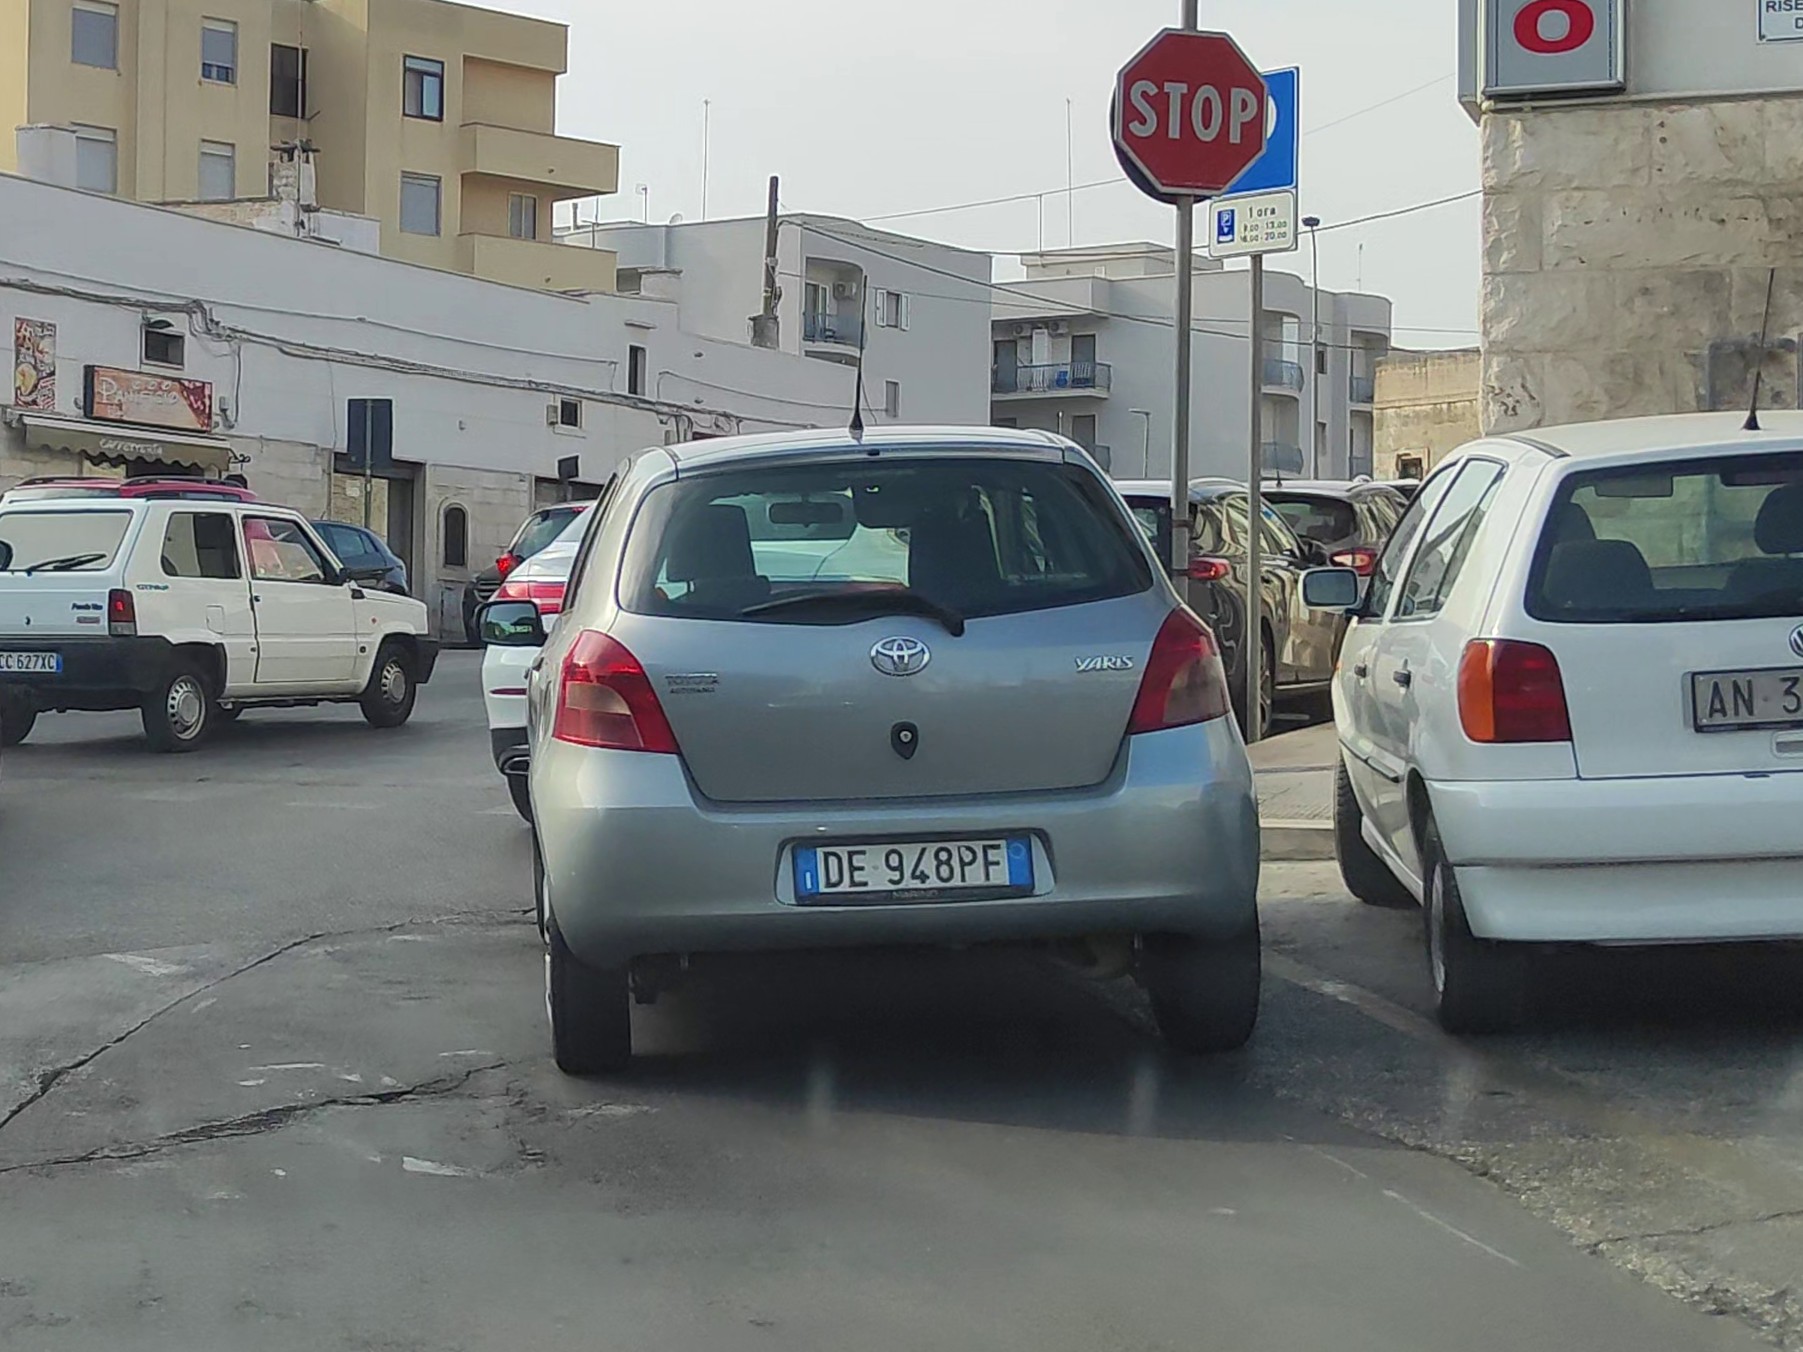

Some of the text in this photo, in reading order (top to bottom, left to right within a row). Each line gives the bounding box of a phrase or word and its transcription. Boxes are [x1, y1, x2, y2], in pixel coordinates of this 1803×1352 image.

[1513, 0, 1594, 55] O
[1128, 80, 1258, 144] STOP
[1257, 207, 1276, 217] ora
[1264, 231, 1287, 241] 20.00
[17, 654, 55, 670] 627XC
[1075, 655, 1134, 672] YARIS
[1709, 679, 1754, 718] AN
[822, 850, 869, 888] DE
[884, 844, 1002, 886] 948PF
